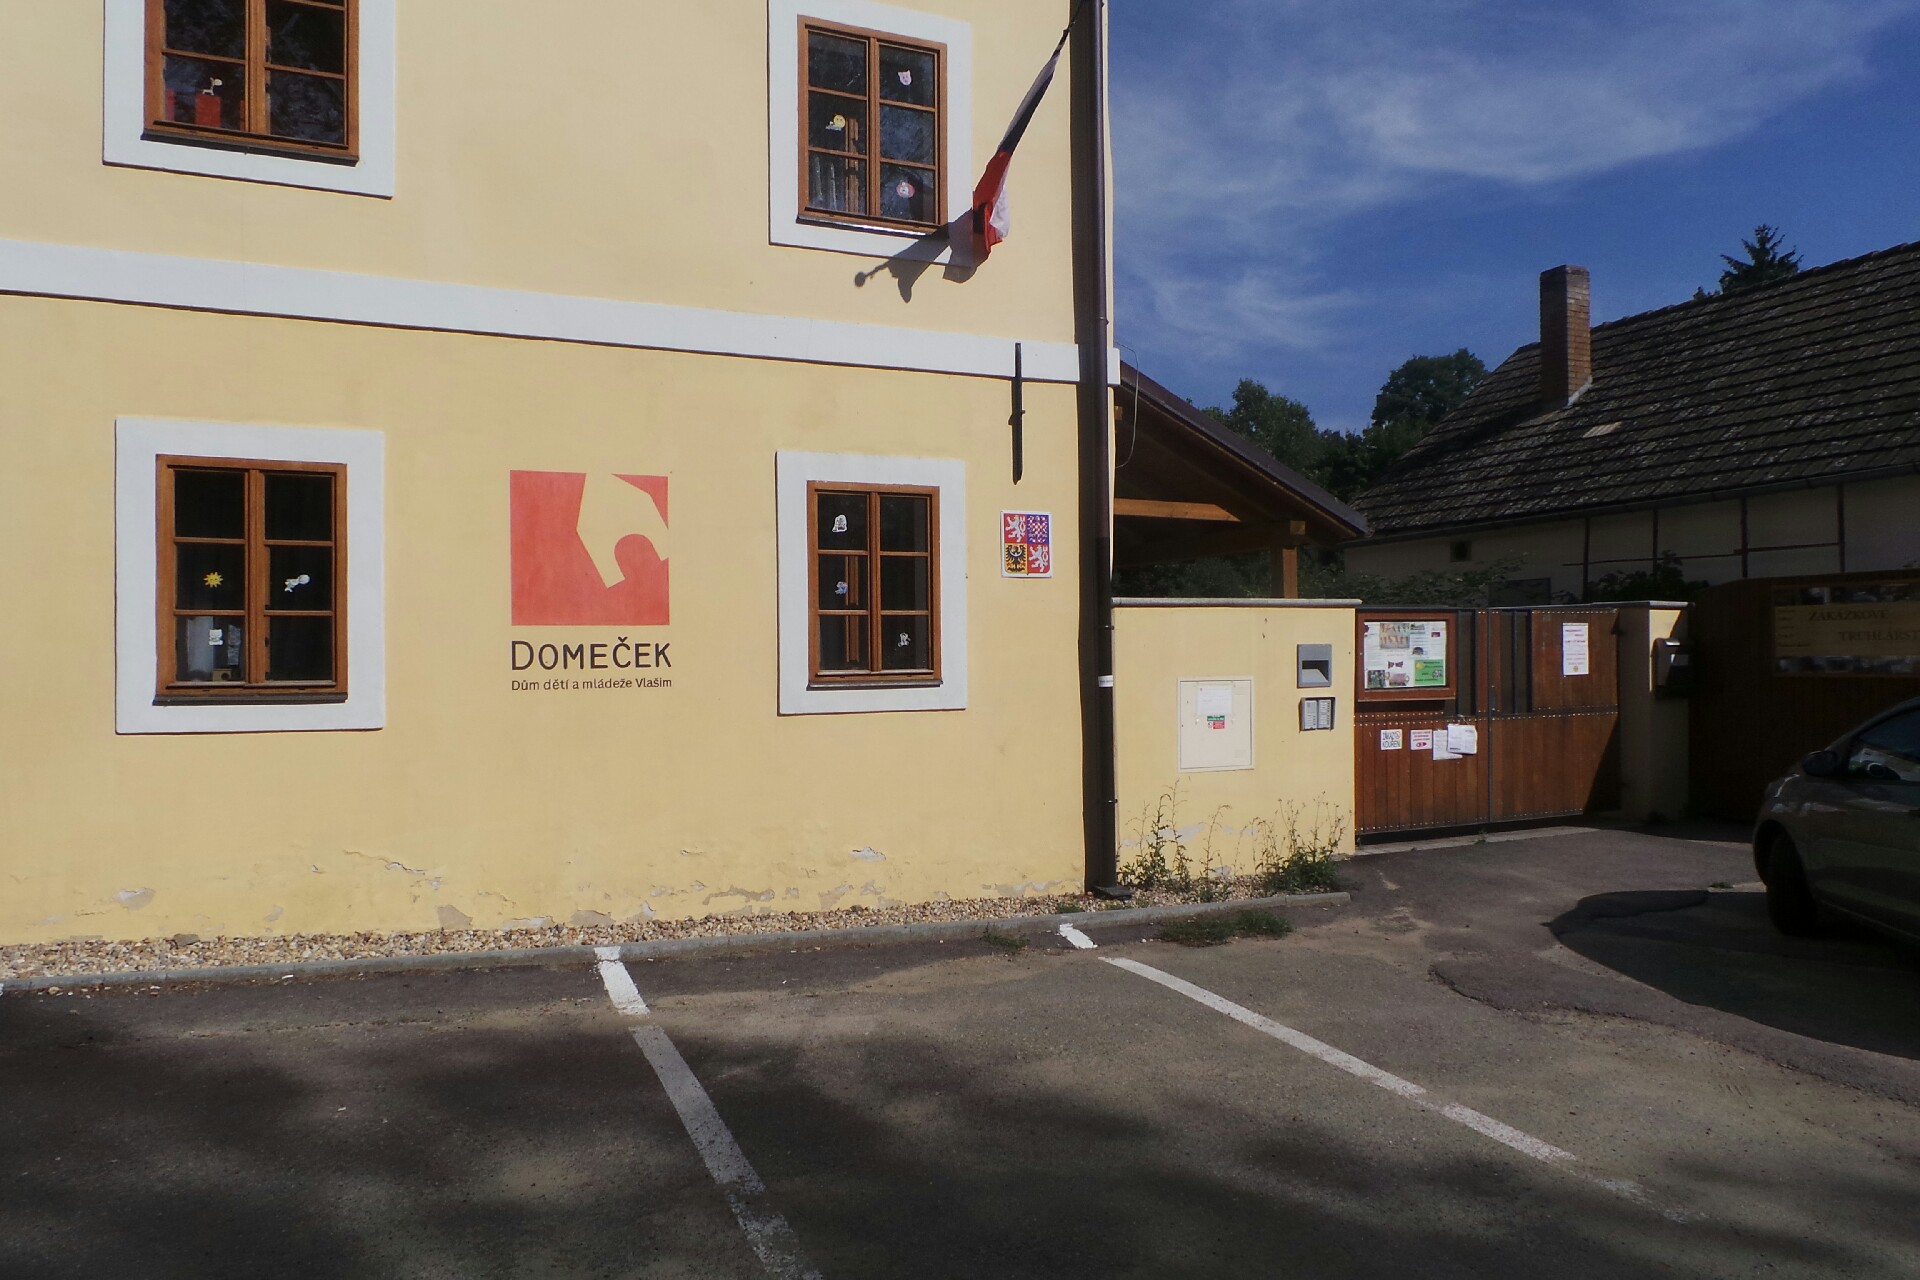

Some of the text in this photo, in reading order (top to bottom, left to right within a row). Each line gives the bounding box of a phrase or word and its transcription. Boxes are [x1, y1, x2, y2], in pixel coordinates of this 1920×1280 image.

[511, 636, 672, 670] DOMEČEK
[511, 677, 672, 691] Dům dětí a mládeže Vlašim
